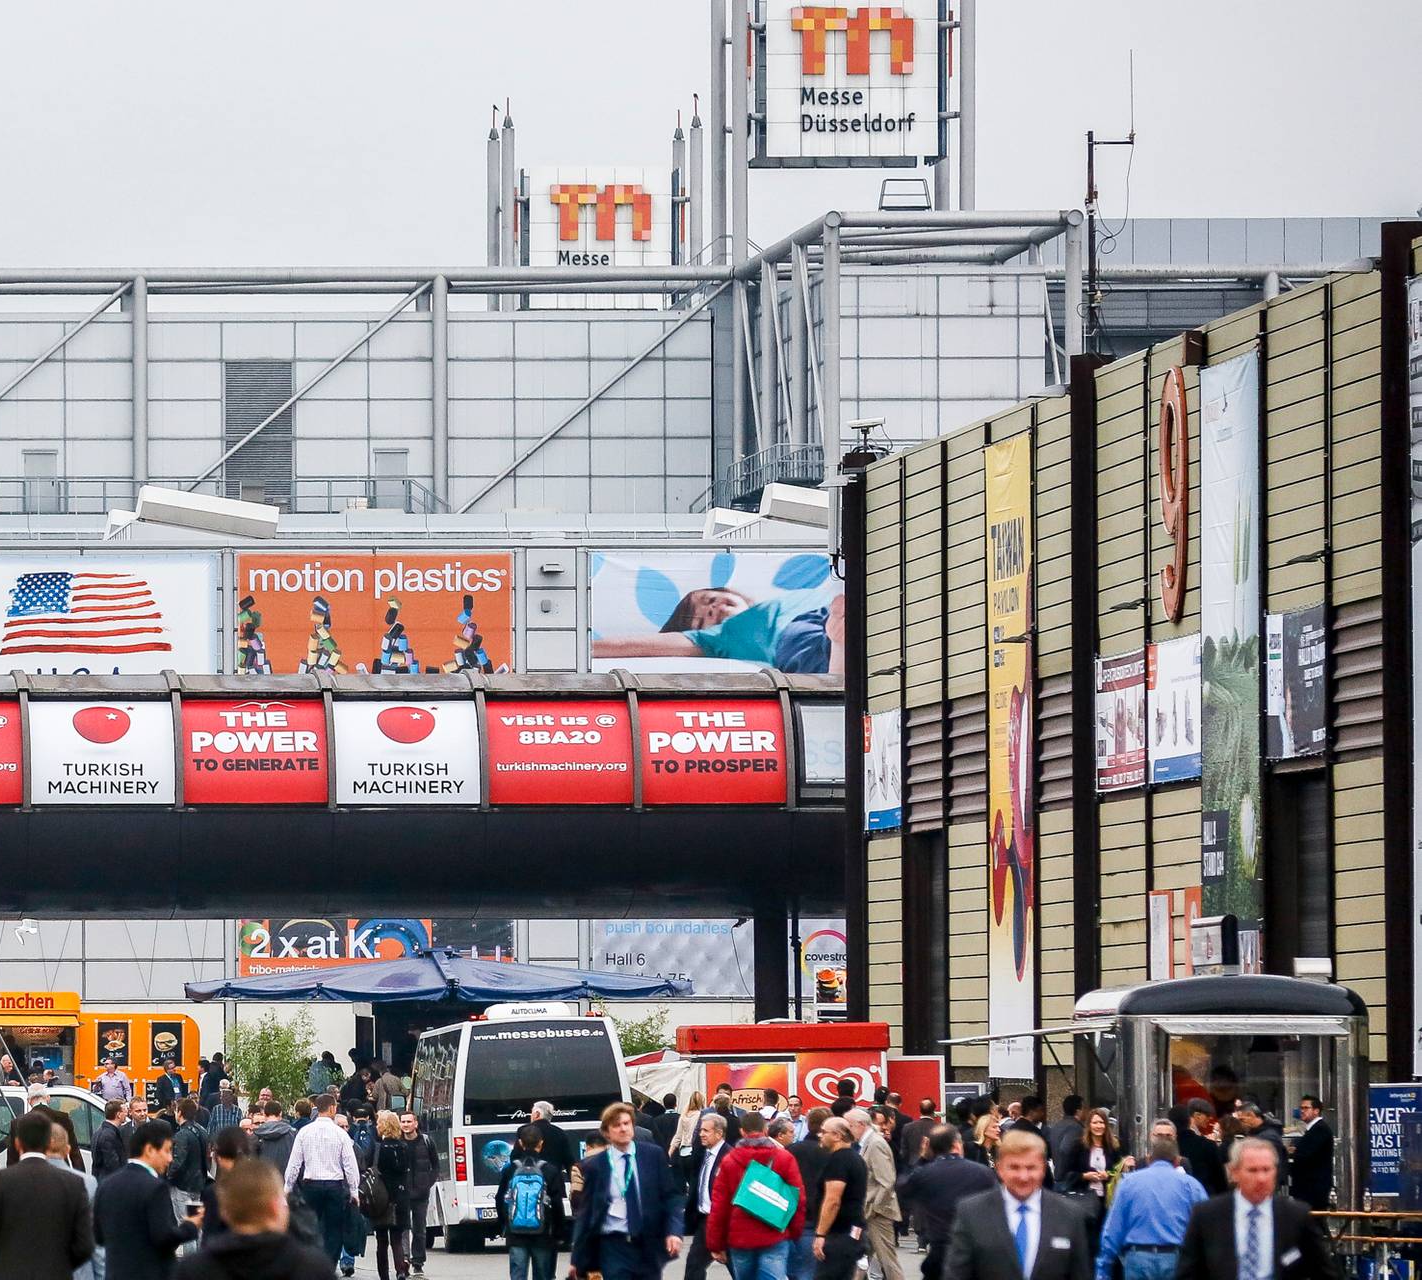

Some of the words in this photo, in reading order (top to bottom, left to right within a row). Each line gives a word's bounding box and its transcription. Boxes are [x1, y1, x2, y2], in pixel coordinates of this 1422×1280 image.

[801, 87, 863, 106] Messe
[801, 112, 916, 133] Düsseldorf
[558, 250, 610, 267] Messe
[1159, 365, 1189, 624] 9
[249, 562, 364, 592] motion
[219, 711, 287, 727] THE
[500, 714, 556, 727] visit
[563, 716, 588, 727] us
[594, 714, 618, 728] @
[675, 711, 746, 727] THE
[192, 731, 319, 753] POWER
[518, 730, 602, 746] 8BA20
[648, 731, 777, 754] POWER
[63, 763, 143, 776] TURKISH
[193, 758, 218, 771] TO
[221, 757, 319, 772] GENERATE
[367, 763, 448, 776] TURKISH
[496, 760, 627, 774] turkishmachinery.org
[651, 759, 679, 774] TO
[684, 758, 778, 774] PROSPER
[48, 781, 159, 795] MACHINERY
[353, 780, 464, 795] MACHINERY
[605, 922, 642, 936] push
[645, 921, 728, 934] boundaries
[250, 929, 270, 958] 2
[278, 936, 299, 958] x
[307, 929, 339, 958] at
[349, 928, 381, 959] K:
[606, 953, 632, 965] Hall
[636, 953, 645, 965] 6
[473, 1028, 605, 1041] www.messebusse.de
[732, 1094, 762, 1103] nfrisch
